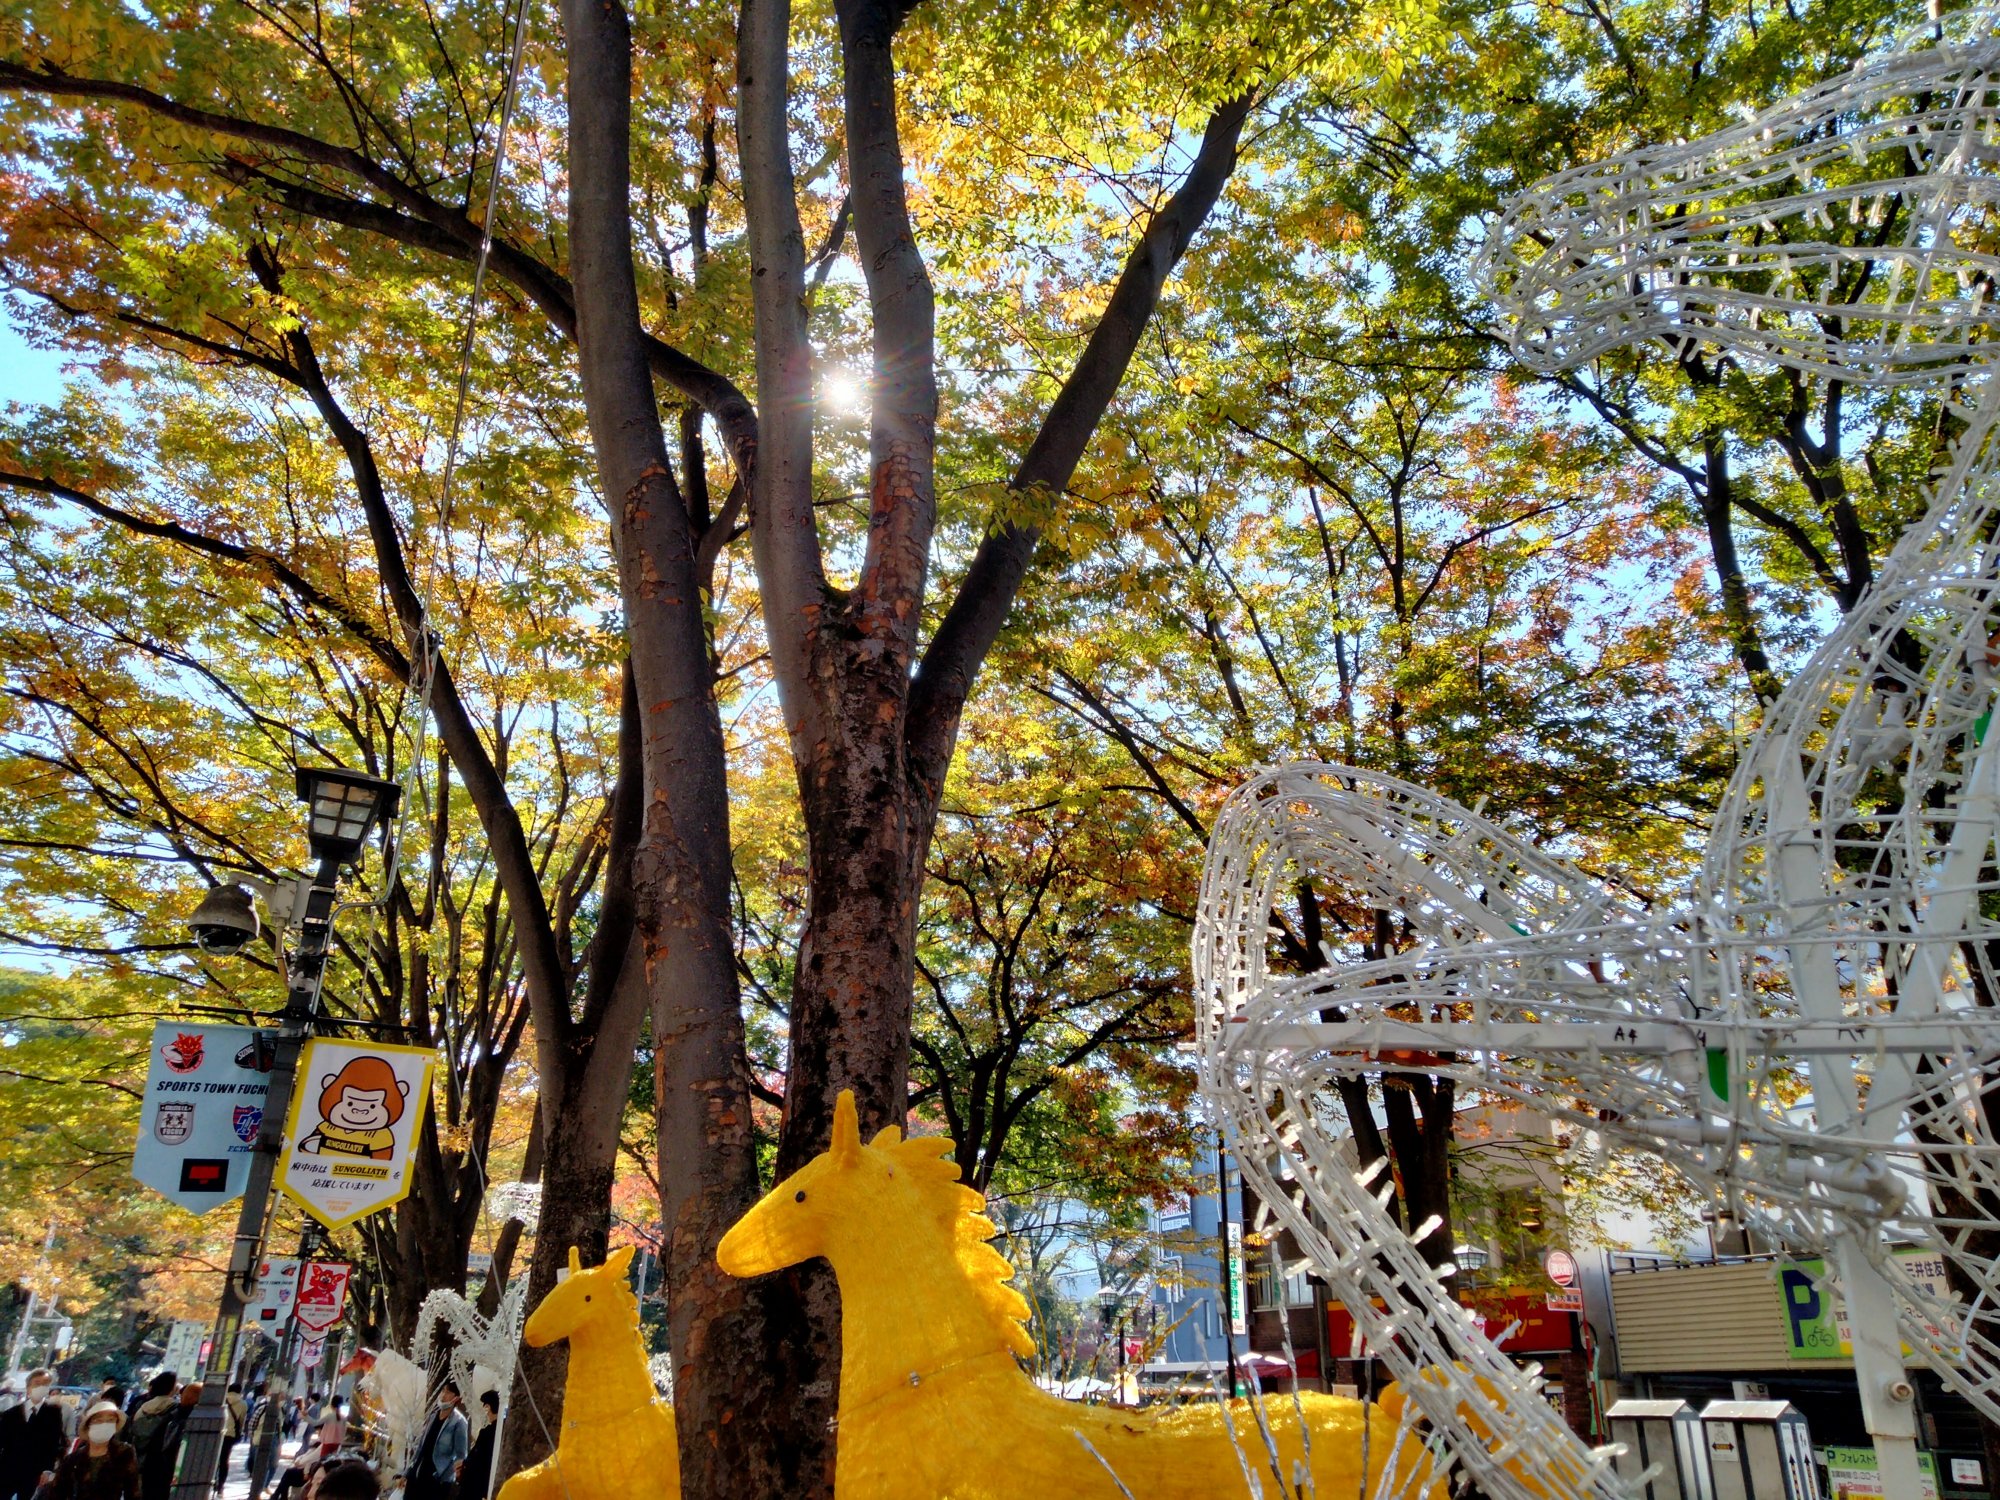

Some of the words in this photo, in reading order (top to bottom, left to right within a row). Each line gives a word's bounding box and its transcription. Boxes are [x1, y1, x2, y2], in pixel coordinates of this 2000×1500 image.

[157, 1081, 201, 1092] SPORTS
[204, 1083, 236, 1094] TOWN
[325, 1139, 364, 1154] SUNGOLIATH
[291, 1162, 328, 1174] 府中市は
[333, 1165, 389, 1177] SUNGOLIATH
[393, 1171, 401, 1180] を
[1782, 1269, 1821, 1347] P
[1826, 1450, 1836, 1464] P
